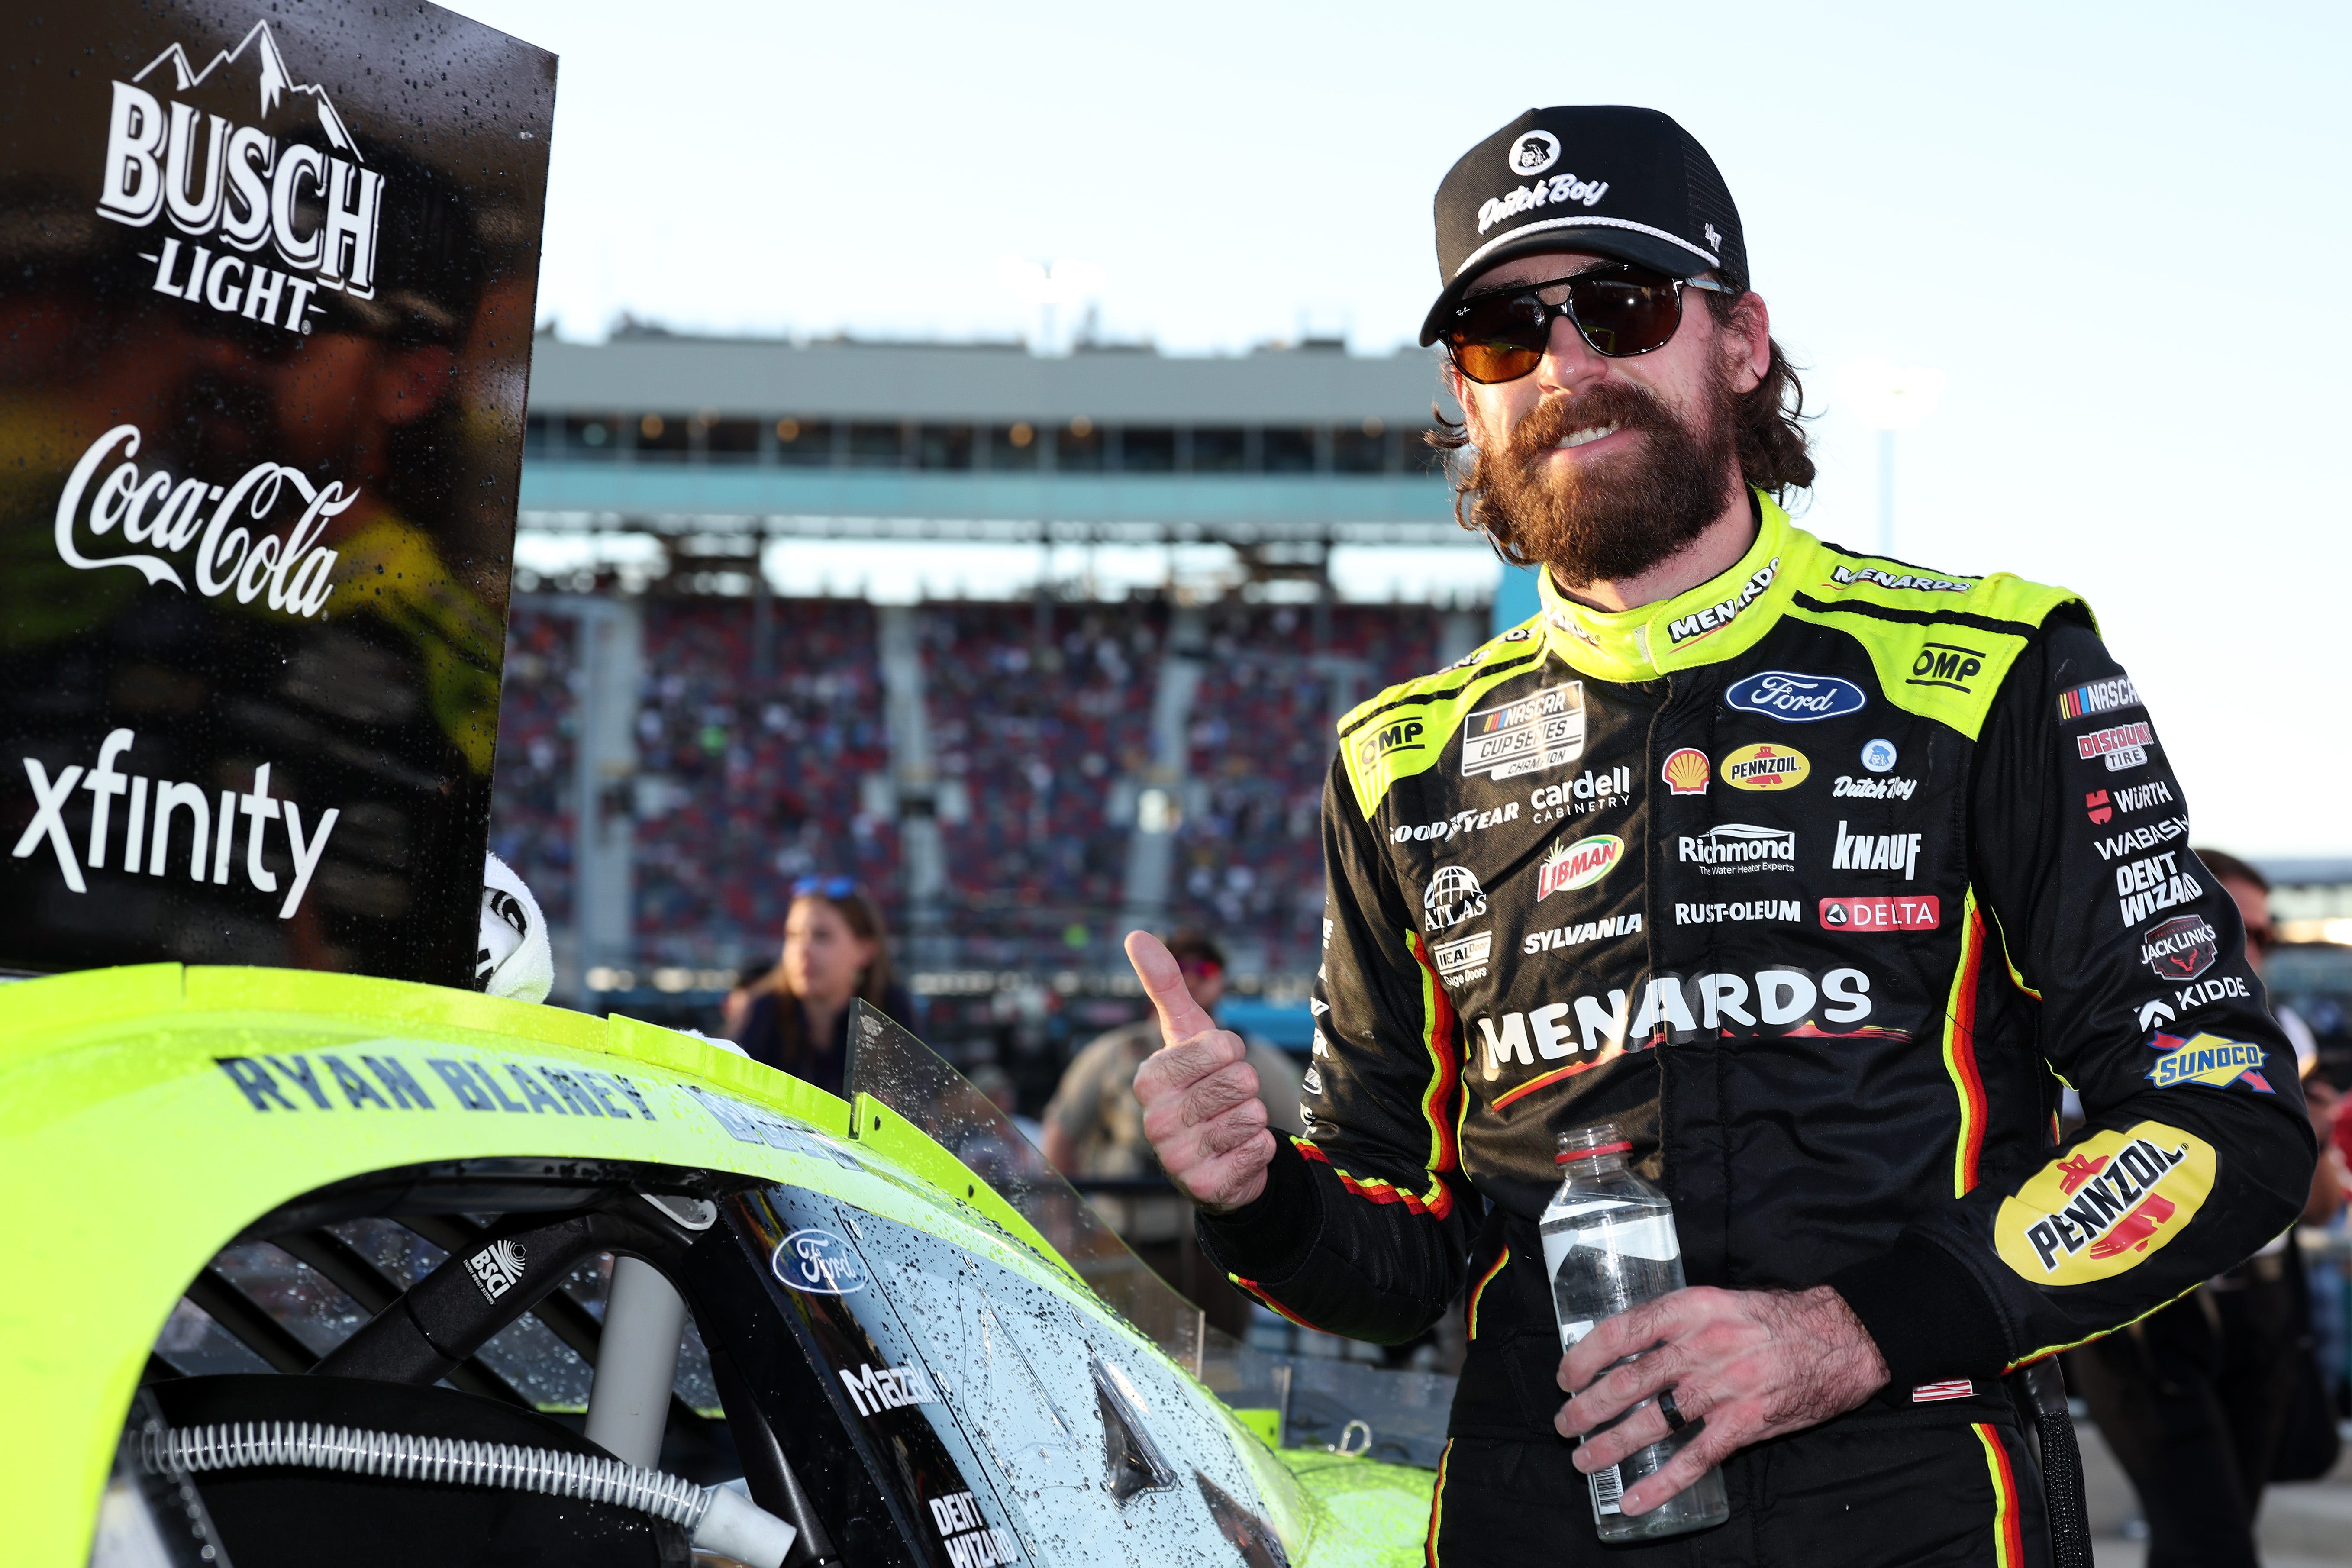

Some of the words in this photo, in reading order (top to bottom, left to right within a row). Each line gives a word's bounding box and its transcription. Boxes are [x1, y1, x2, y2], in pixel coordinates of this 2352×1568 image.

[96, 81, 384, 300] BUSCH
[1478, 179, 1550, 235] Dutch
[1548, 173, 1610, 206] Boy
[152, 238, 317, 332] LIGHT
[55, 424, 361, 618] Coca-Cola
[1831, 565, 1971, 592] MENARDS
[1913, 649, 1981, 682] OMP
[1503, 691, 1566, 728] NASCAR
[1750, 672, 1838, 712] Ford
[1362, 722, 1423, 765] OMP
[1480, 735, 1513, 758] CUP
[2077, 721, 2155, 760] DISCOUNT
[2109, 749, 2143, 768] TIRE
[1530, 765, 1630, 811] cardell
[1730, 755, 1798, 781] PENNZOIL
[1832, 775, 1887, 799] Dutch
[1533, 794, 1630, 824] CABINETRY
[2113, 781, 2174, 813] WÜRTH
[11, 728, 340, 919] xfinity
[1678, 832, 1795, 865] Richmond
[1538, 841, 1619, 902] LIBMAN
[1699, 865, 1711, 876] The
[1711, 866, 1736, 875] Water
[1738, 864, 1761, 874] Heater
[1762, 862, 1794, 872] Experts
[2116, 850, 2178, 896] DENT
[1424, 892, 1488, 932] ATLAS
[1675, 900, 1801, 925] RUST-OLEUM
[1853, 903, 1935, 926] DELTA
[1469, 942, 1488, 952] Door
[1523, 913, 1642, 955] SYLVANIA
[2141, 937, 2180, 964] JACK
[2174, 925, 2216, 950] LINK'S
[1465, 966, 1487, 982] Doors
[2175, 976, 2251, 1011] KIDDE
[1477, 968, 1872, 1082] MENARDS
[2159, 1045, 2260, 1084] SUNOCO
[213, 1054, 436, 1112] RYAN
[426, 1058, 657, 1121] BLANEY
[2024, 1138, 2189, 1274] PENNZOIL
[463, 1259, 474, 1274] ENERGY
[471, 1273, 484, 1288] IMPACT
[481, 1287, 495, 1305] SYSTEMS
[470, 1249, 511, 1298] BSCI
[838, 1358, 941, 1417] Mazak
[929, 1491, 983, 1537] DENT
[943, 1527, 1018, 1568] WIZARD
